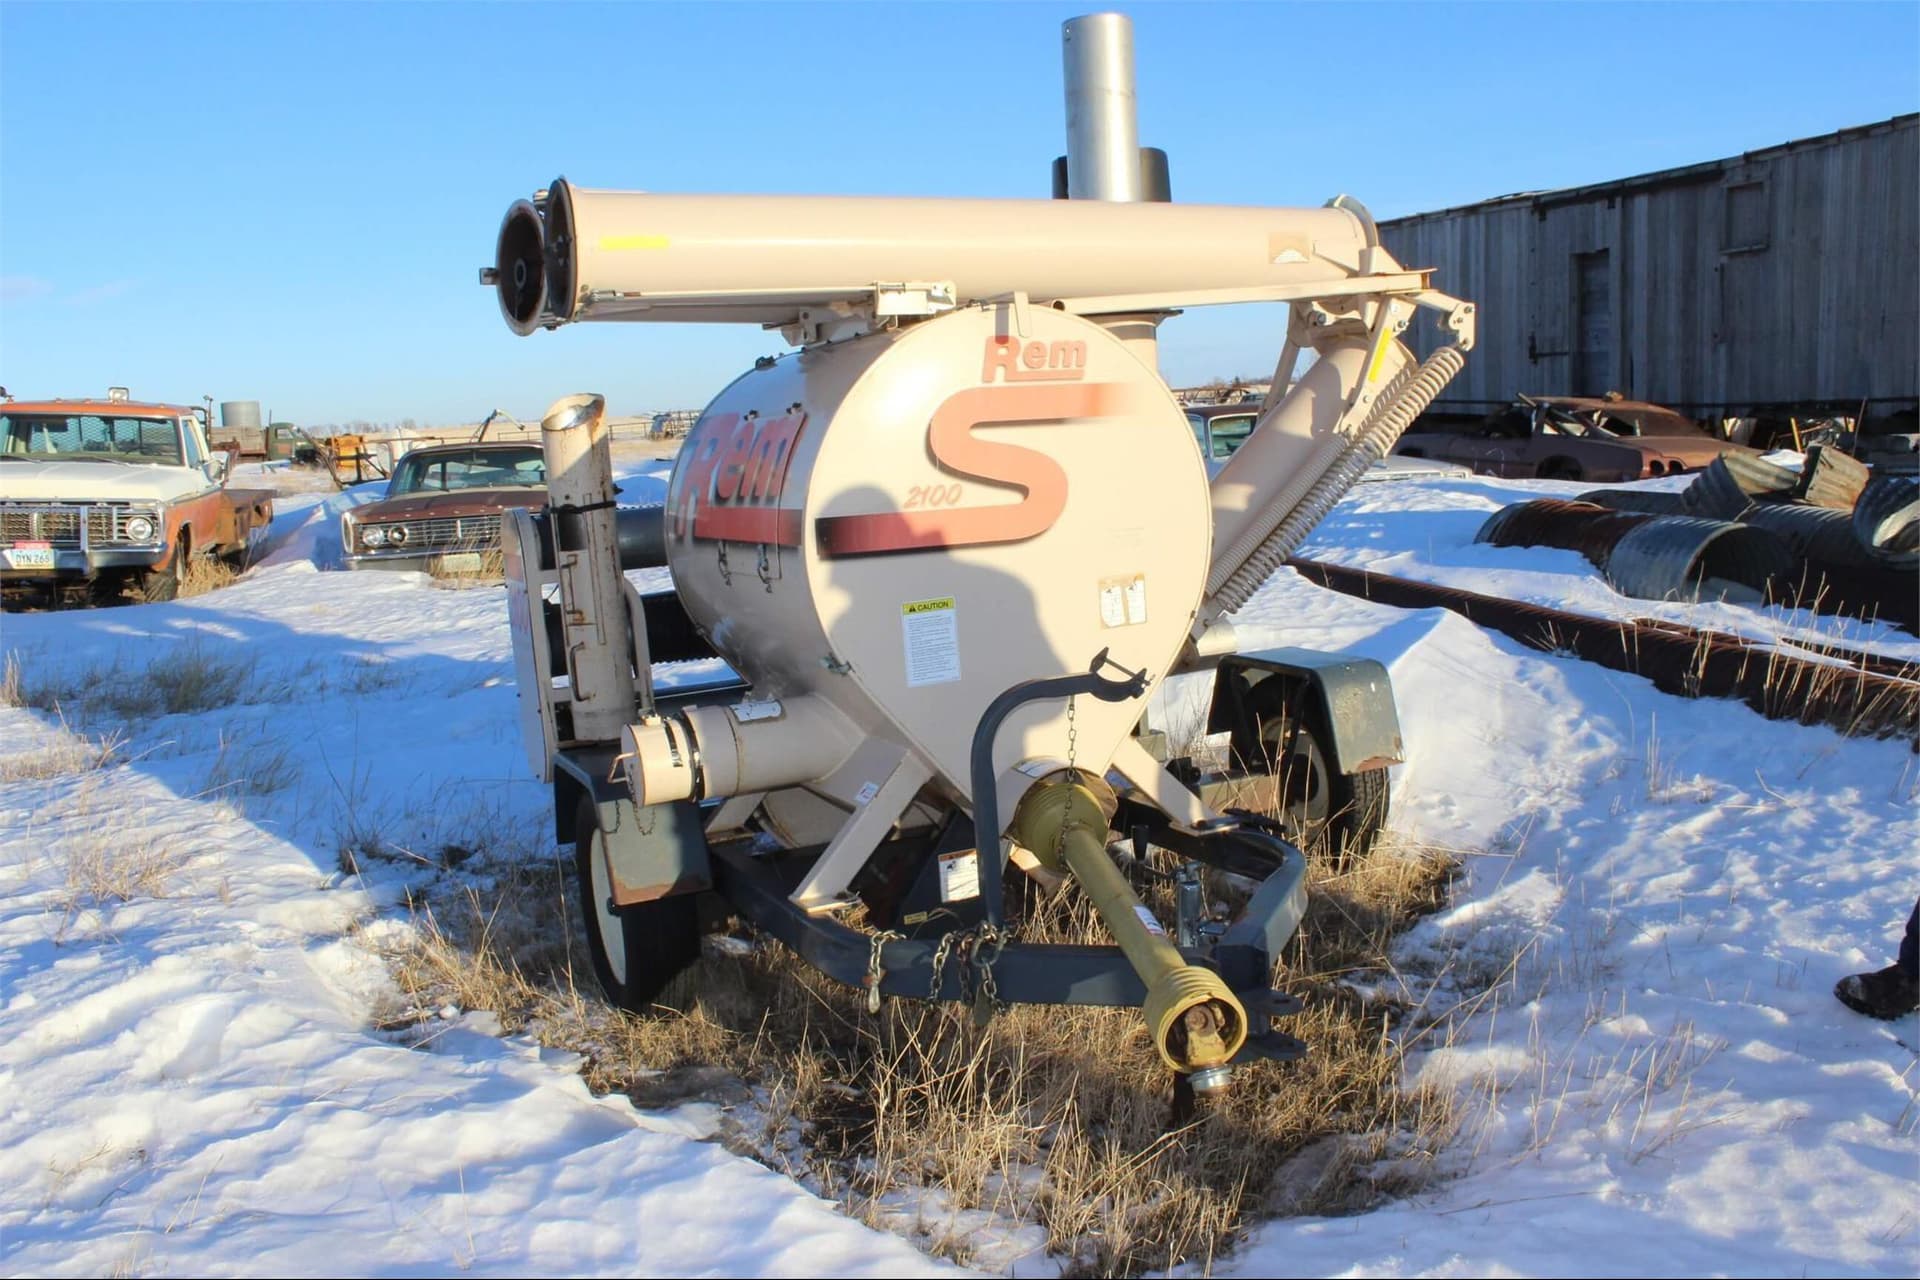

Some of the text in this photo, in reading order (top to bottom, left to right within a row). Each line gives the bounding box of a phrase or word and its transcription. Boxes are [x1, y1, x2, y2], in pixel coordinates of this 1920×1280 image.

[981, 335, 1087, 383] Rem
[675, 411, 810, 541] Rem
[903, 483, 962, 509] 2100
[917, 600, 949, 611] CAUTION
